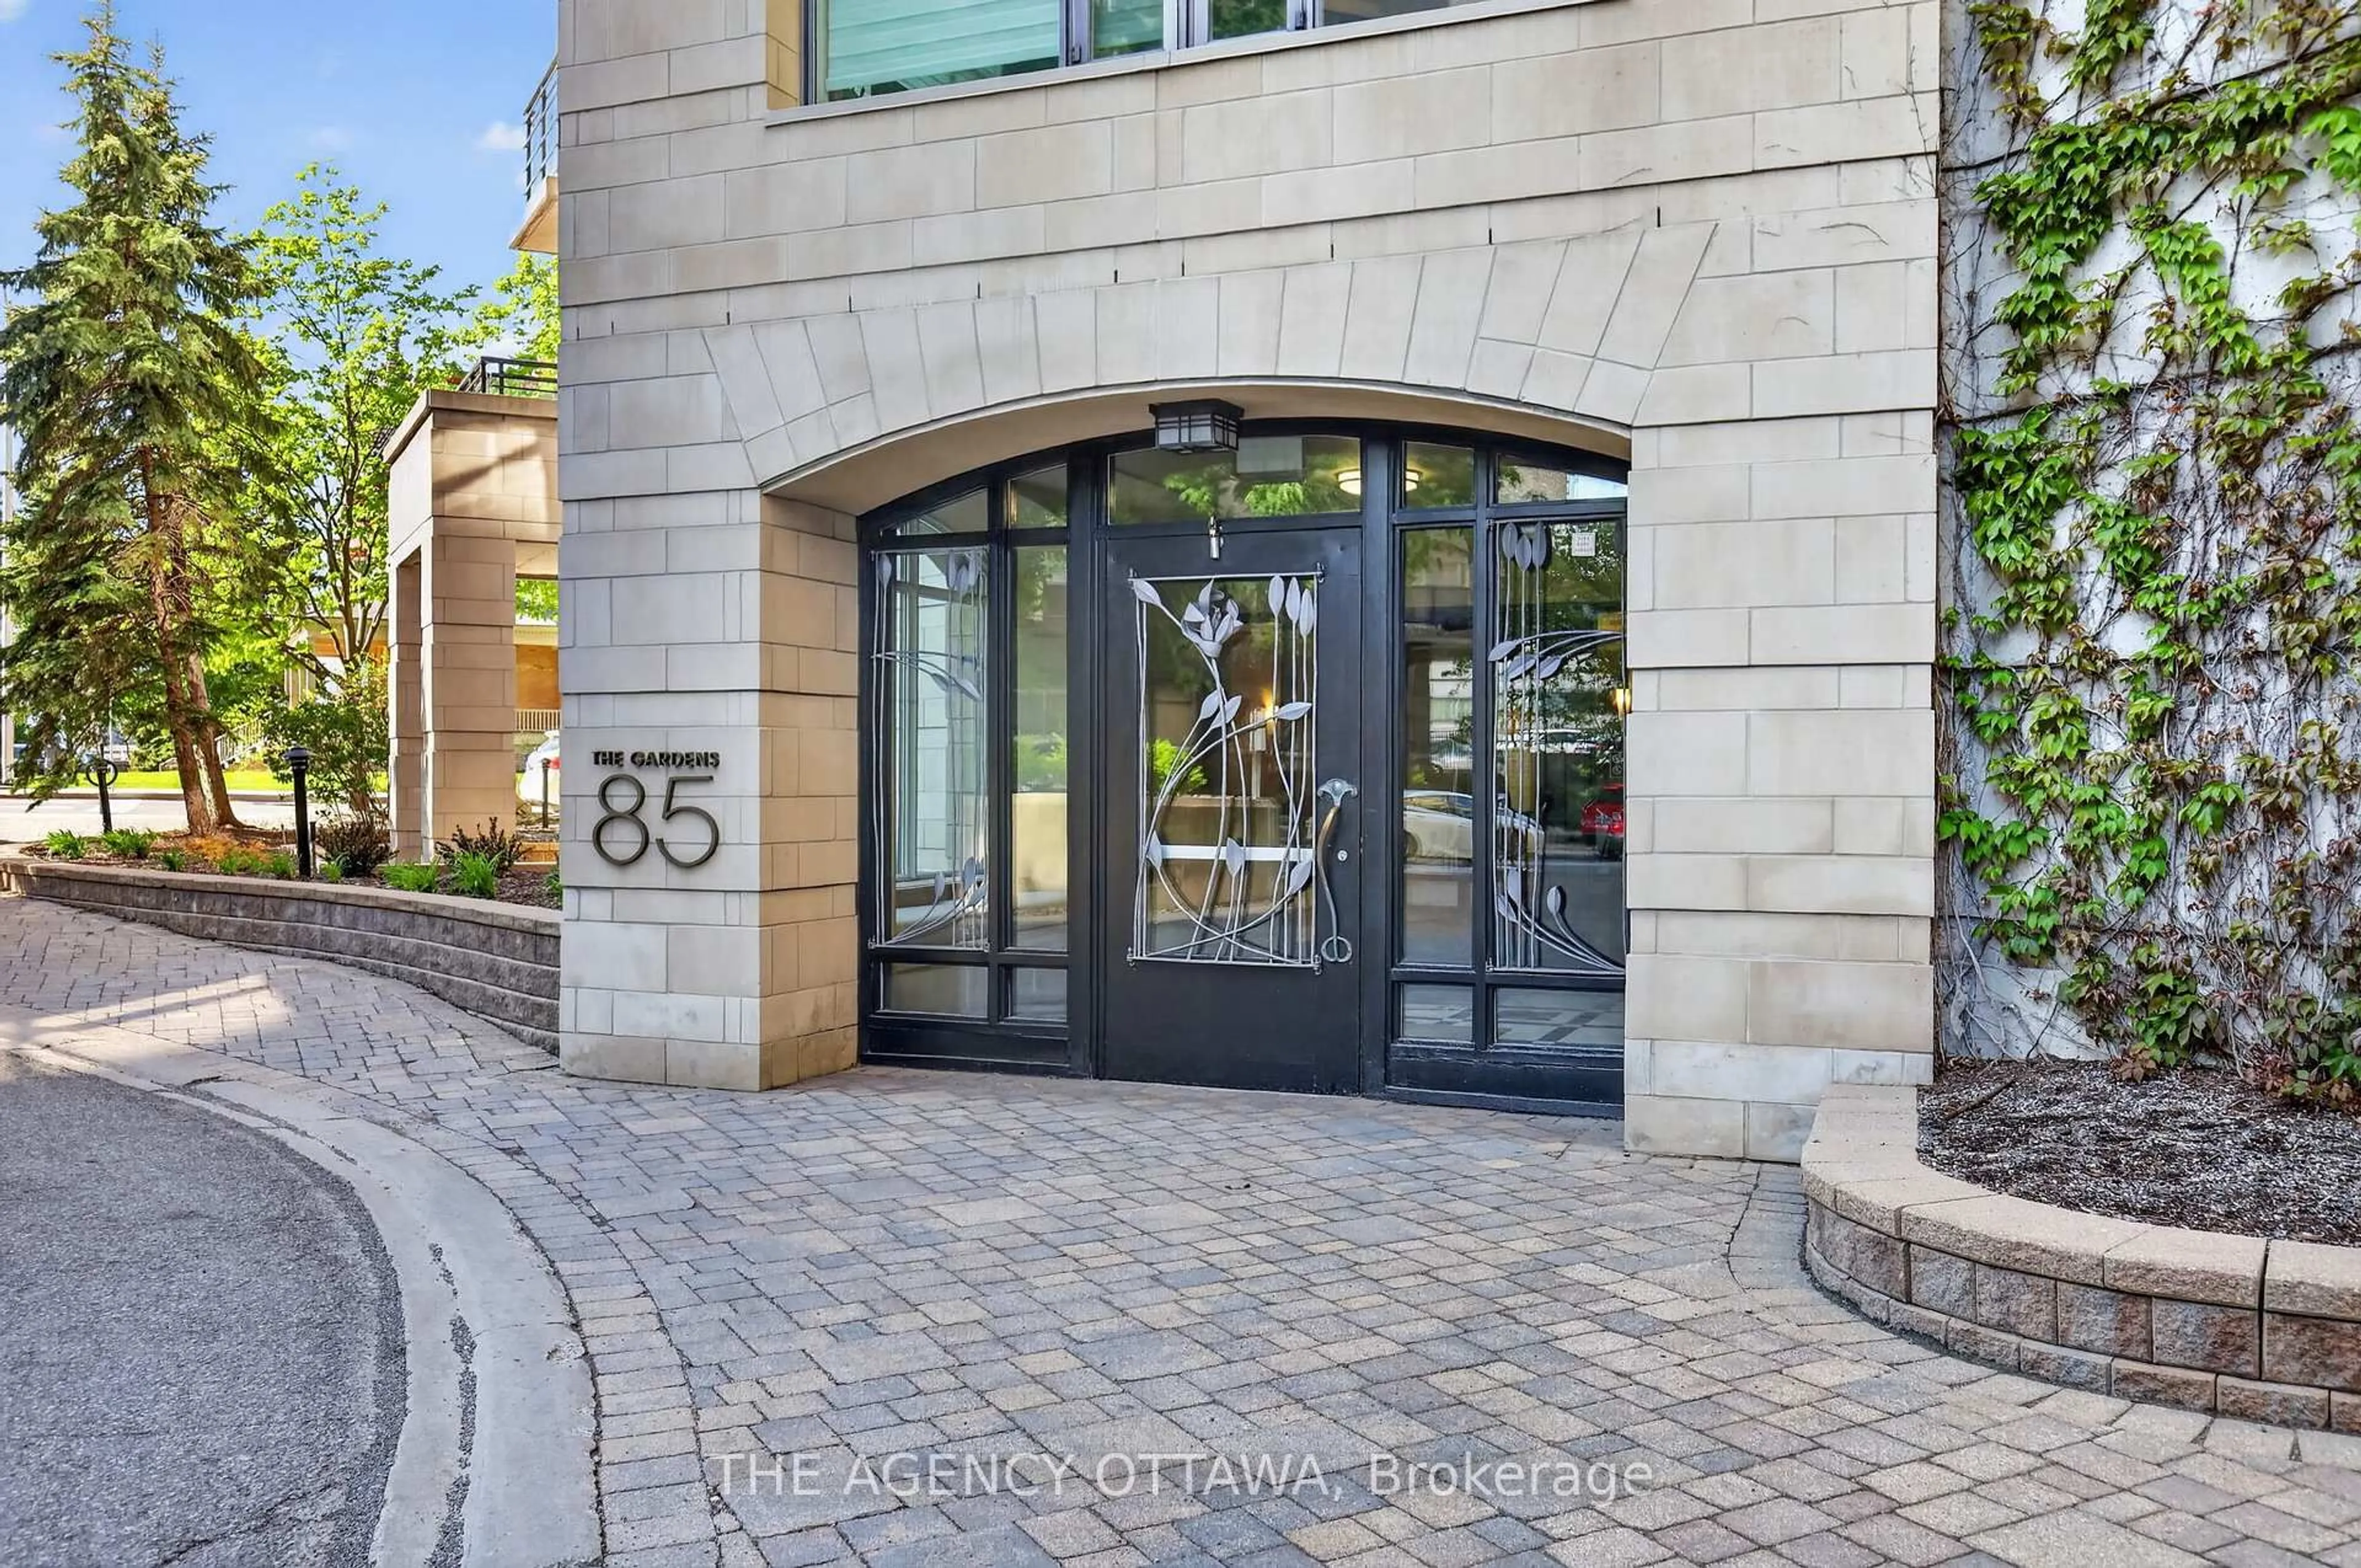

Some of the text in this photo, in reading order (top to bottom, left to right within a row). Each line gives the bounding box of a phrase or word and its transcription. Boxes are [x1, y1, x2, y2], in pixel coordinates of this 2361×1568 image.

[593, 751, 720, 768] THE GARDENS
[592, 774, 719, 868] 85
